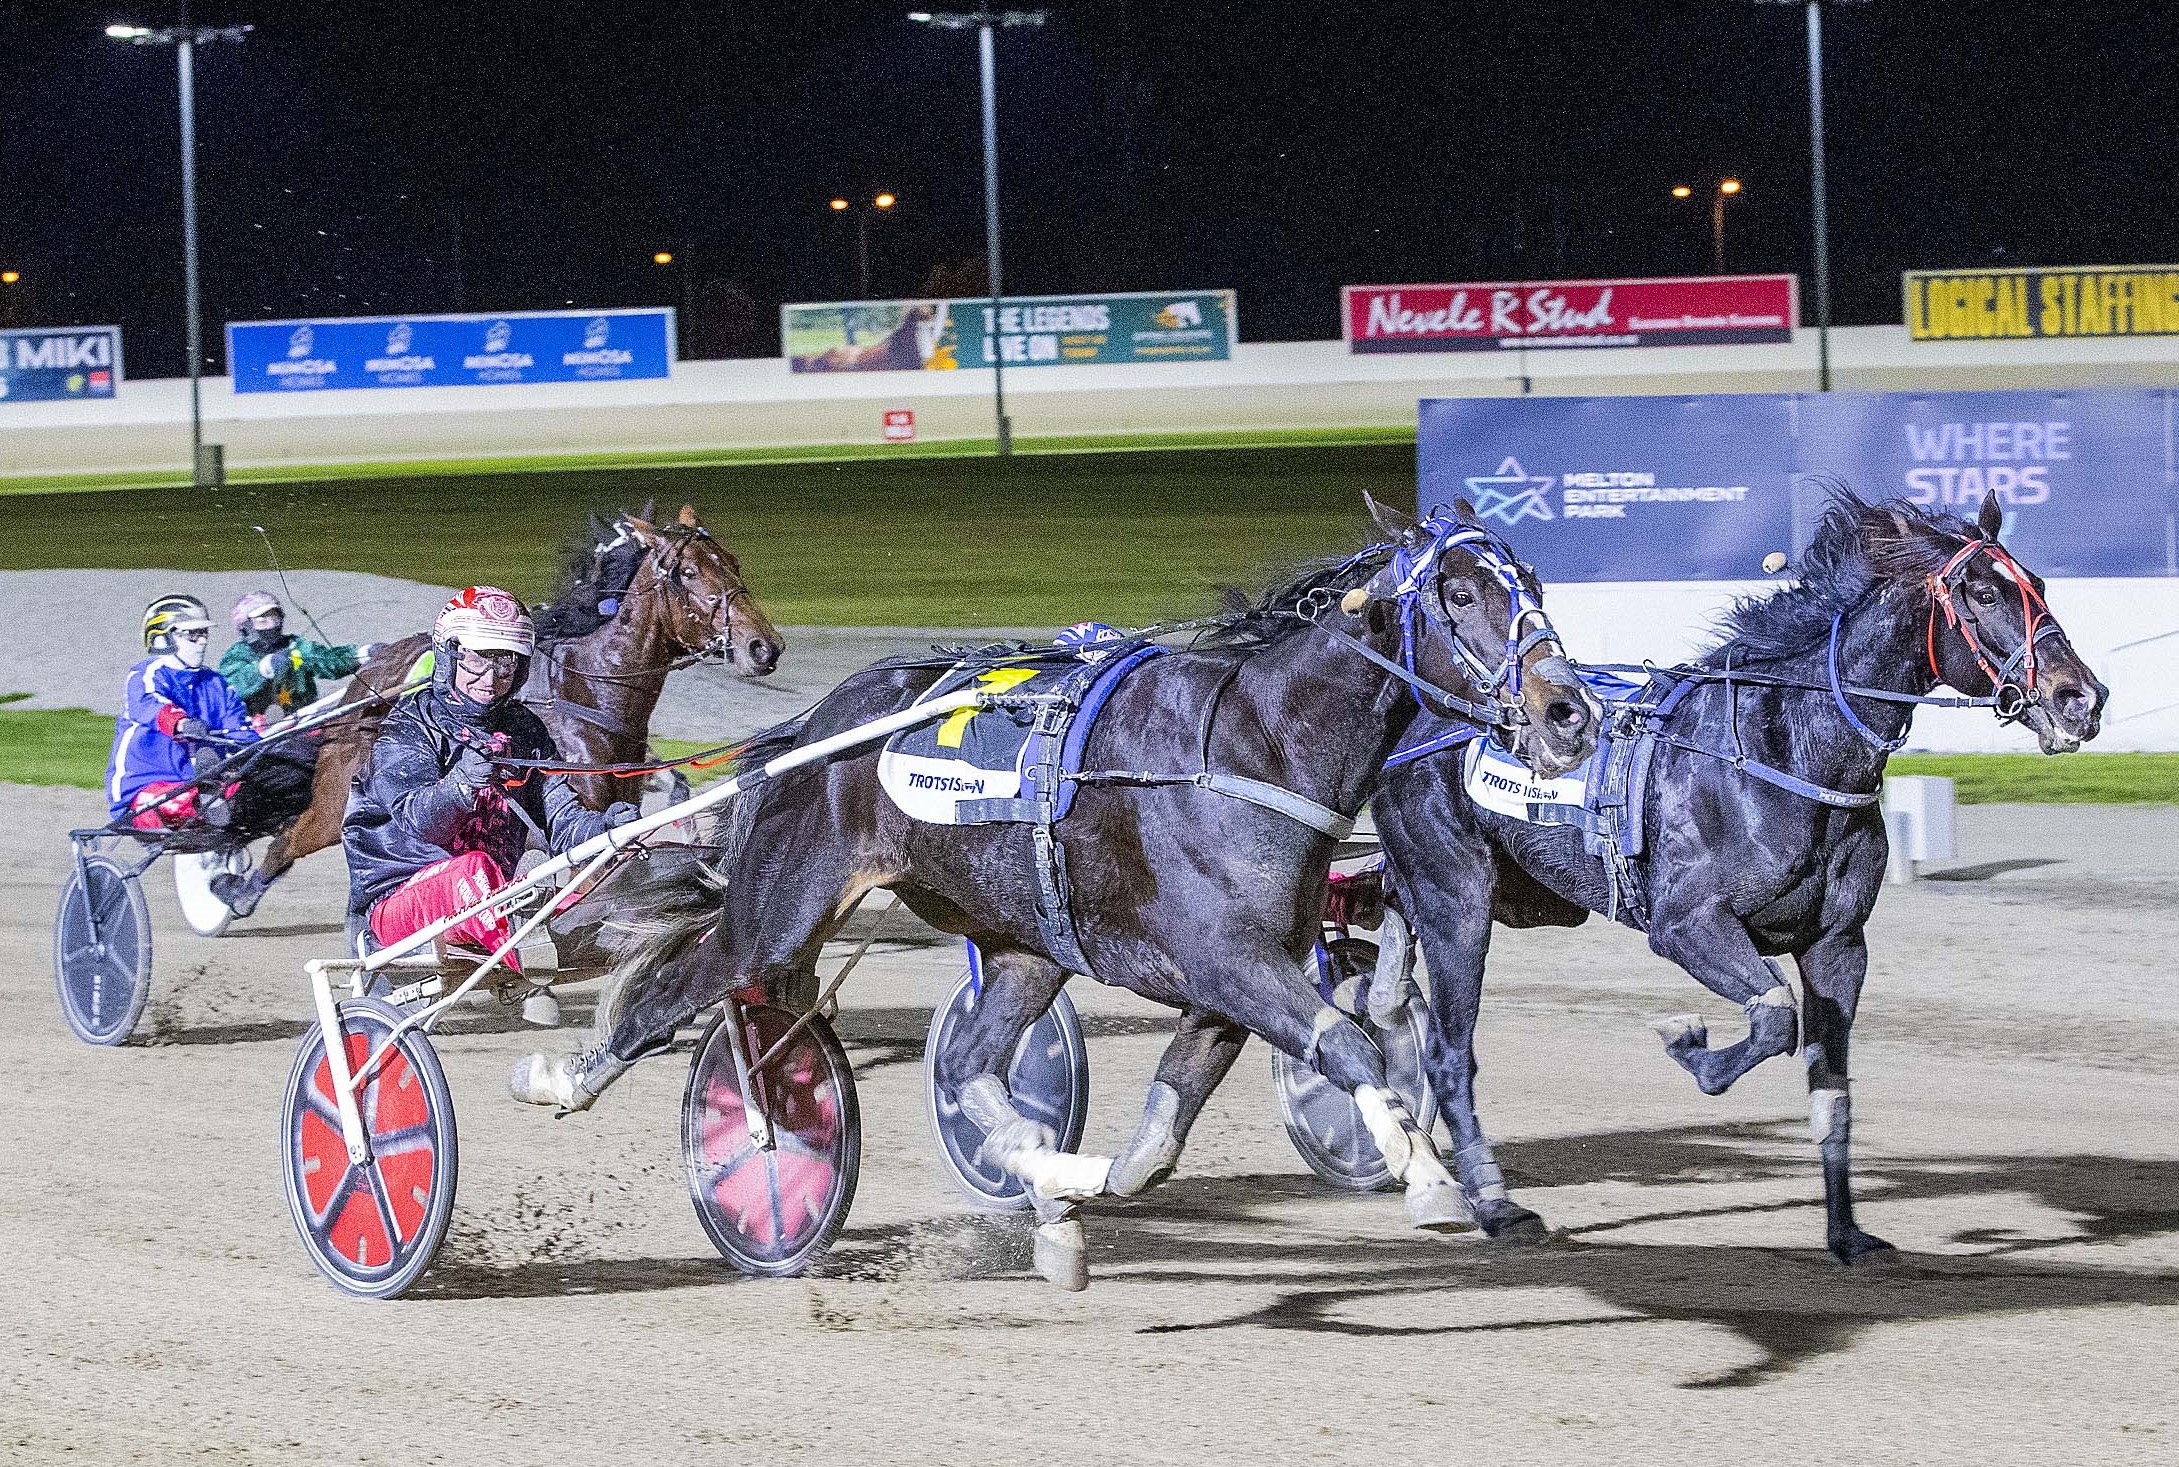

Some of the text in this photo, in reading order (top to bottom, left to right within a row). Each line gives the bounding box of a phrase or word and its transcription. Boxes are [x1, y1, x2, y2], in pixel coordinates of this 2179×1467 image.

[1023, 304, 1110, 332] LEGENDS
[1366, 288, 1613, 337] Nevele R Stud
[1911, 277, 2034, 337] LOGICAL
[17, 336, 110, 369] MIKI
[983, 335, 1028, 362] LVE
[1905, 422, 2072, 461] WHERE
[1563, 472, 1656, 487] MELTON
[1563, 486, 1750, 502] ENTERTAINMENT
[1905, 466, 2050, 505] STARS
[1563, 503, 1626, 518] PARK
